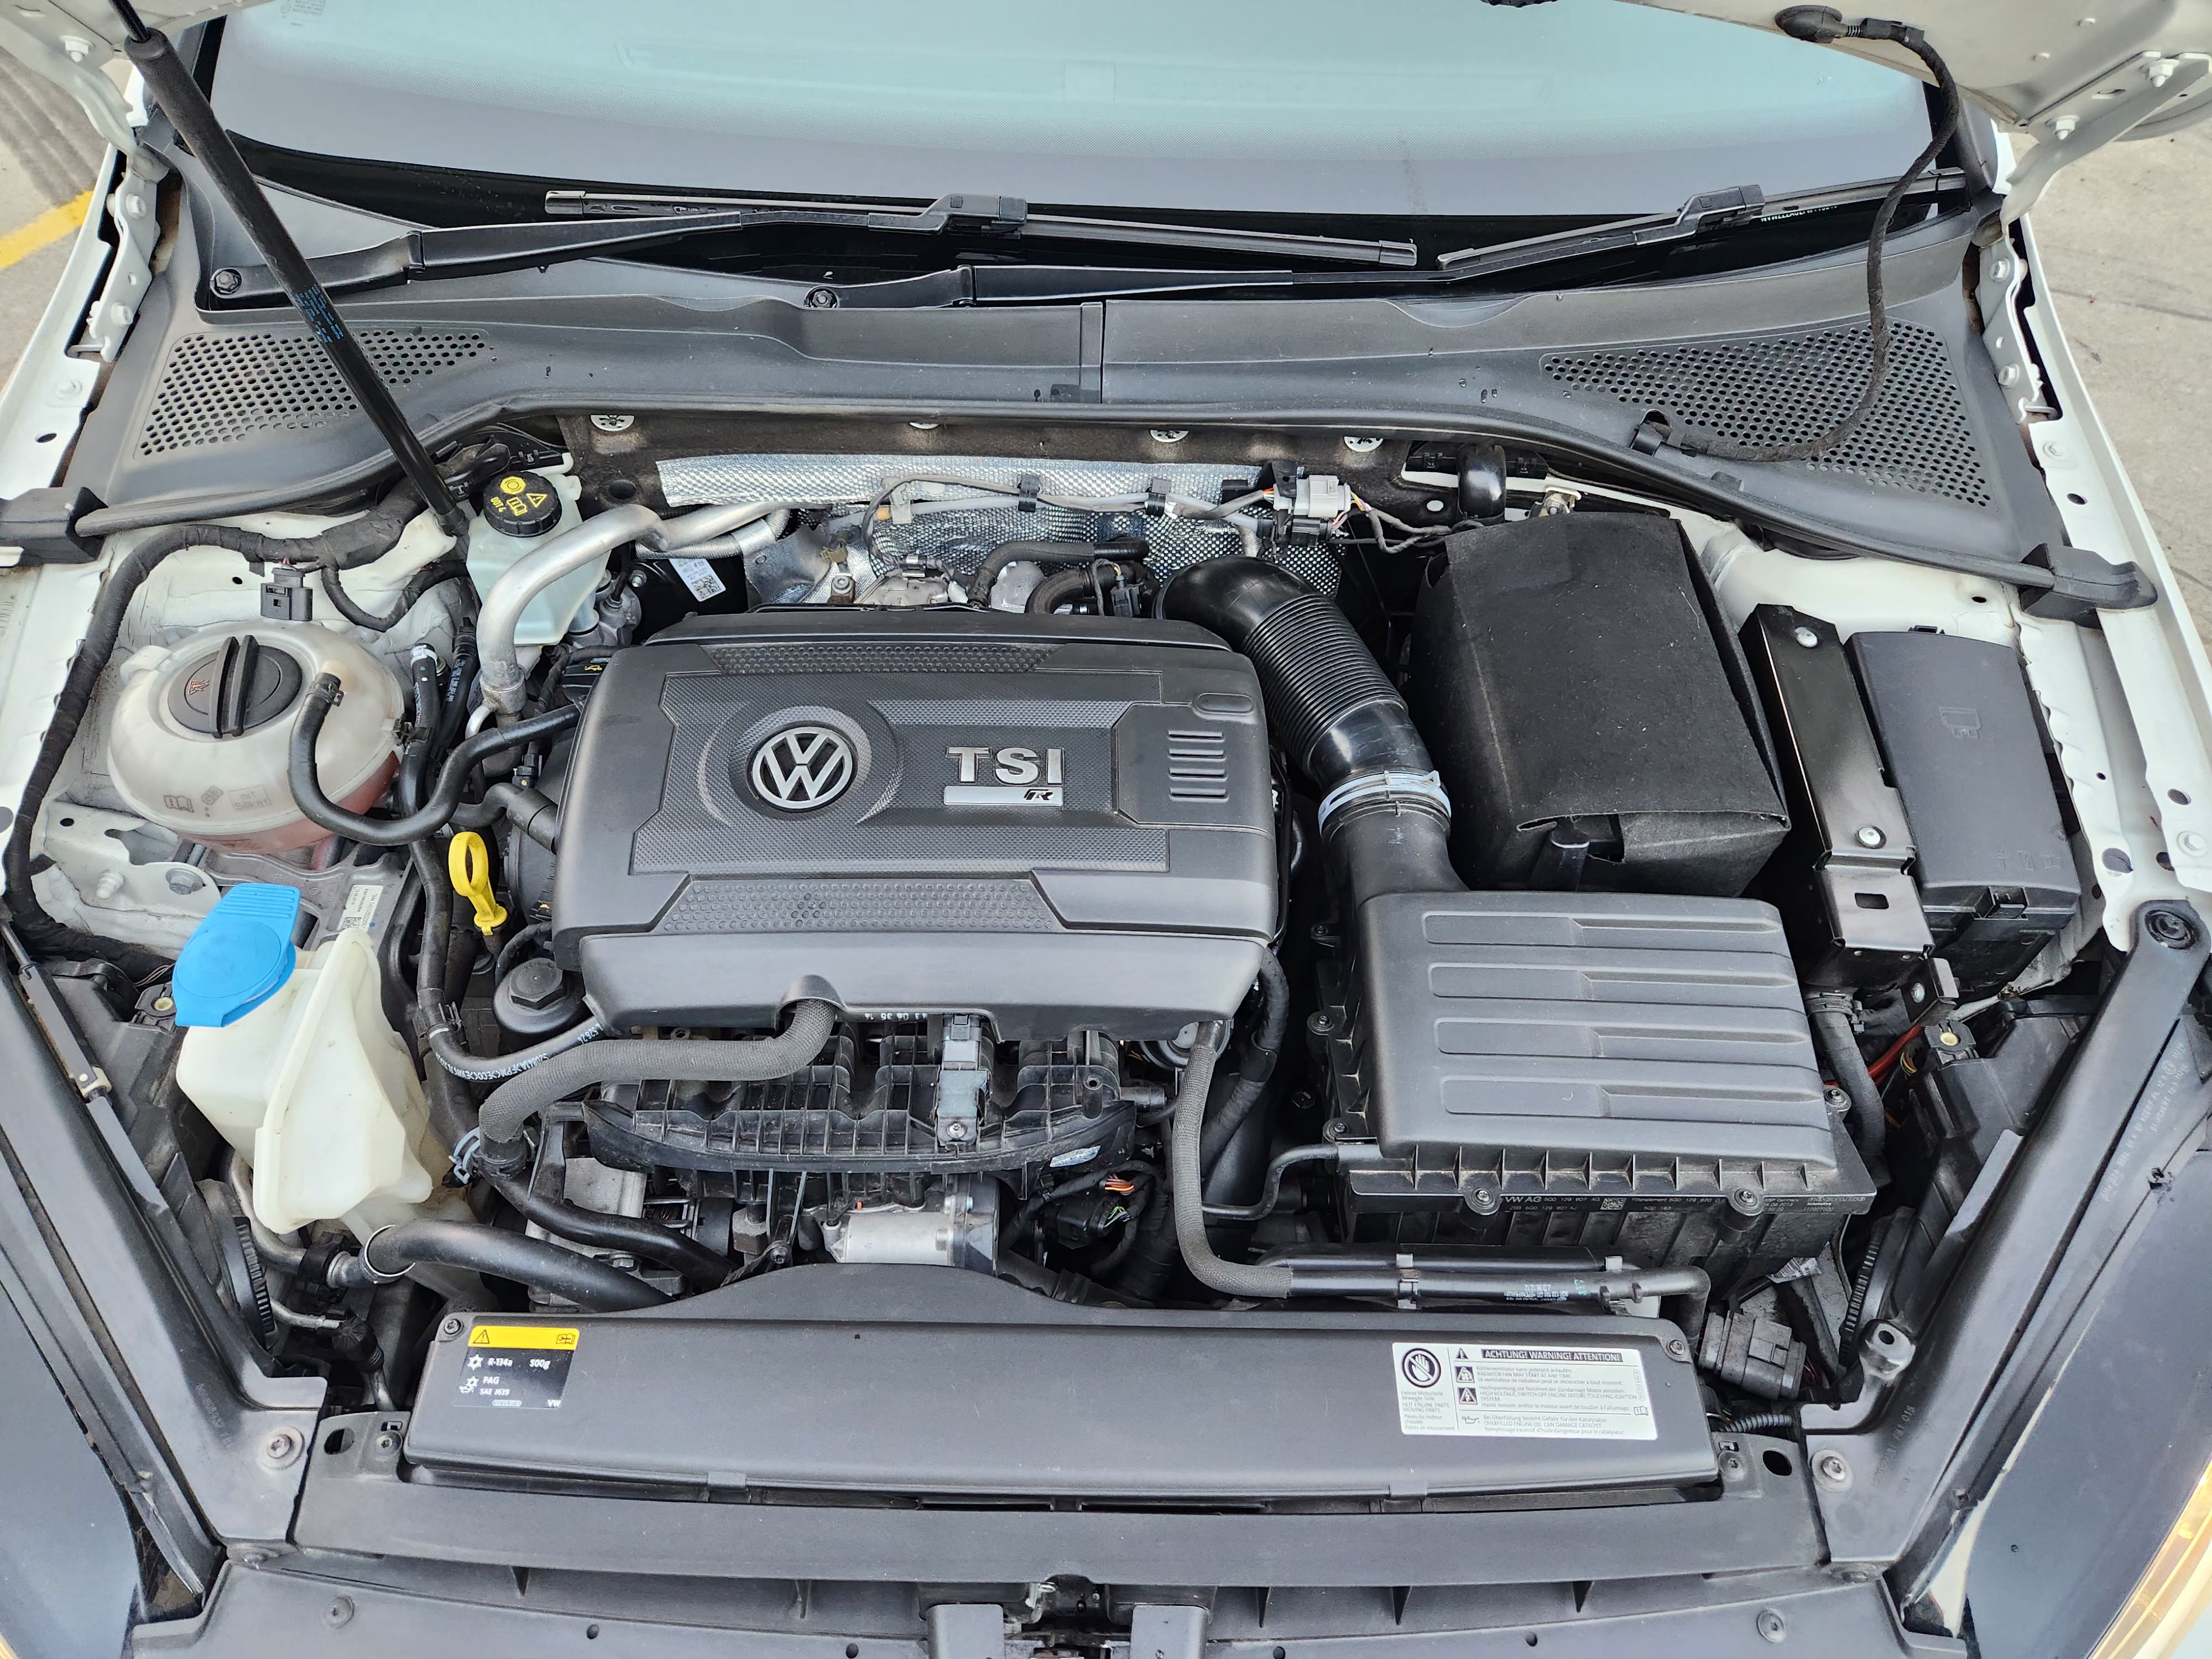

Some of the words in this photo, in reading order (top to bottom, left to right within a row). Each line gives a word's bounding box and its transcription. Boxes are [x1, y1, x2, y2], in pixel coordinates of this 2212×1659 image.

[750, 726, 854, 809] VW
[946, 746, 1065, 785] TSI
[235, 799, 270, 810] Silikat
[1485, 1350, 1528, 1359] ACHTUNG!
[1529, 1351, 1572, 1360] WARNING!
[1573, 1352, 1620, 1361] ATTENTION!
[487, 1358, 513, 1367] R-134a
[529, 1359, 551, 1370] 500g
[482, 1376, 500, 1385] PAG
